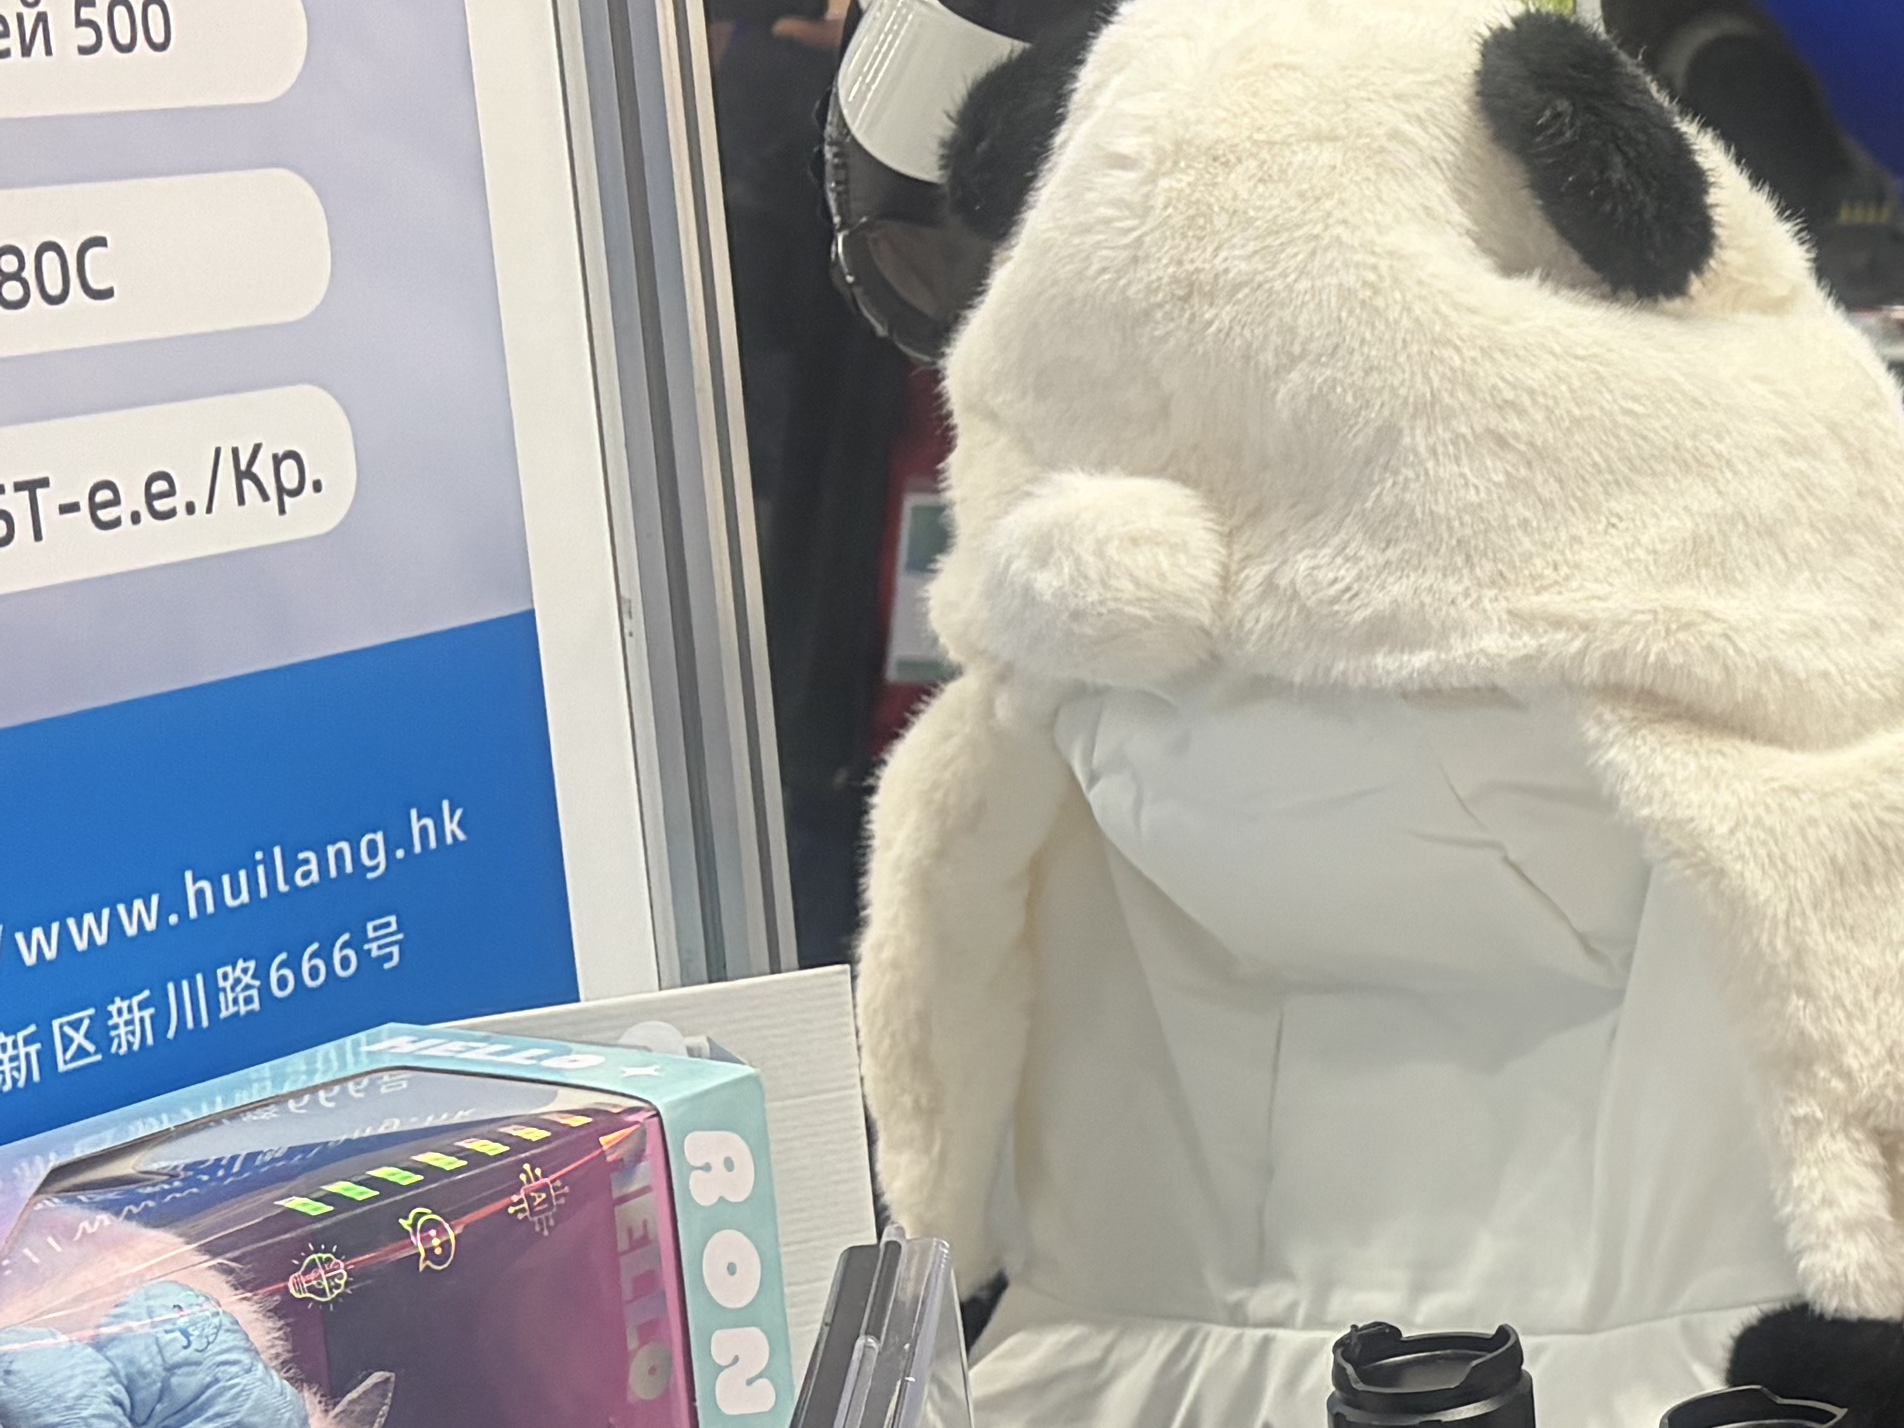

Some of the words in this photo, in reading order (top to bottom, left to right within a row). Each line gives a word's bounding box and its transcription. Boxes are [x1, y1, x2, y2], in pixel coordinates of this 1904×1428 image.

[0, 798, 468, 969] www.huilang.hk
[0, 913, 407, 1094] 新区新川路666号
[361, 1035, 606, 1069] HELLO
